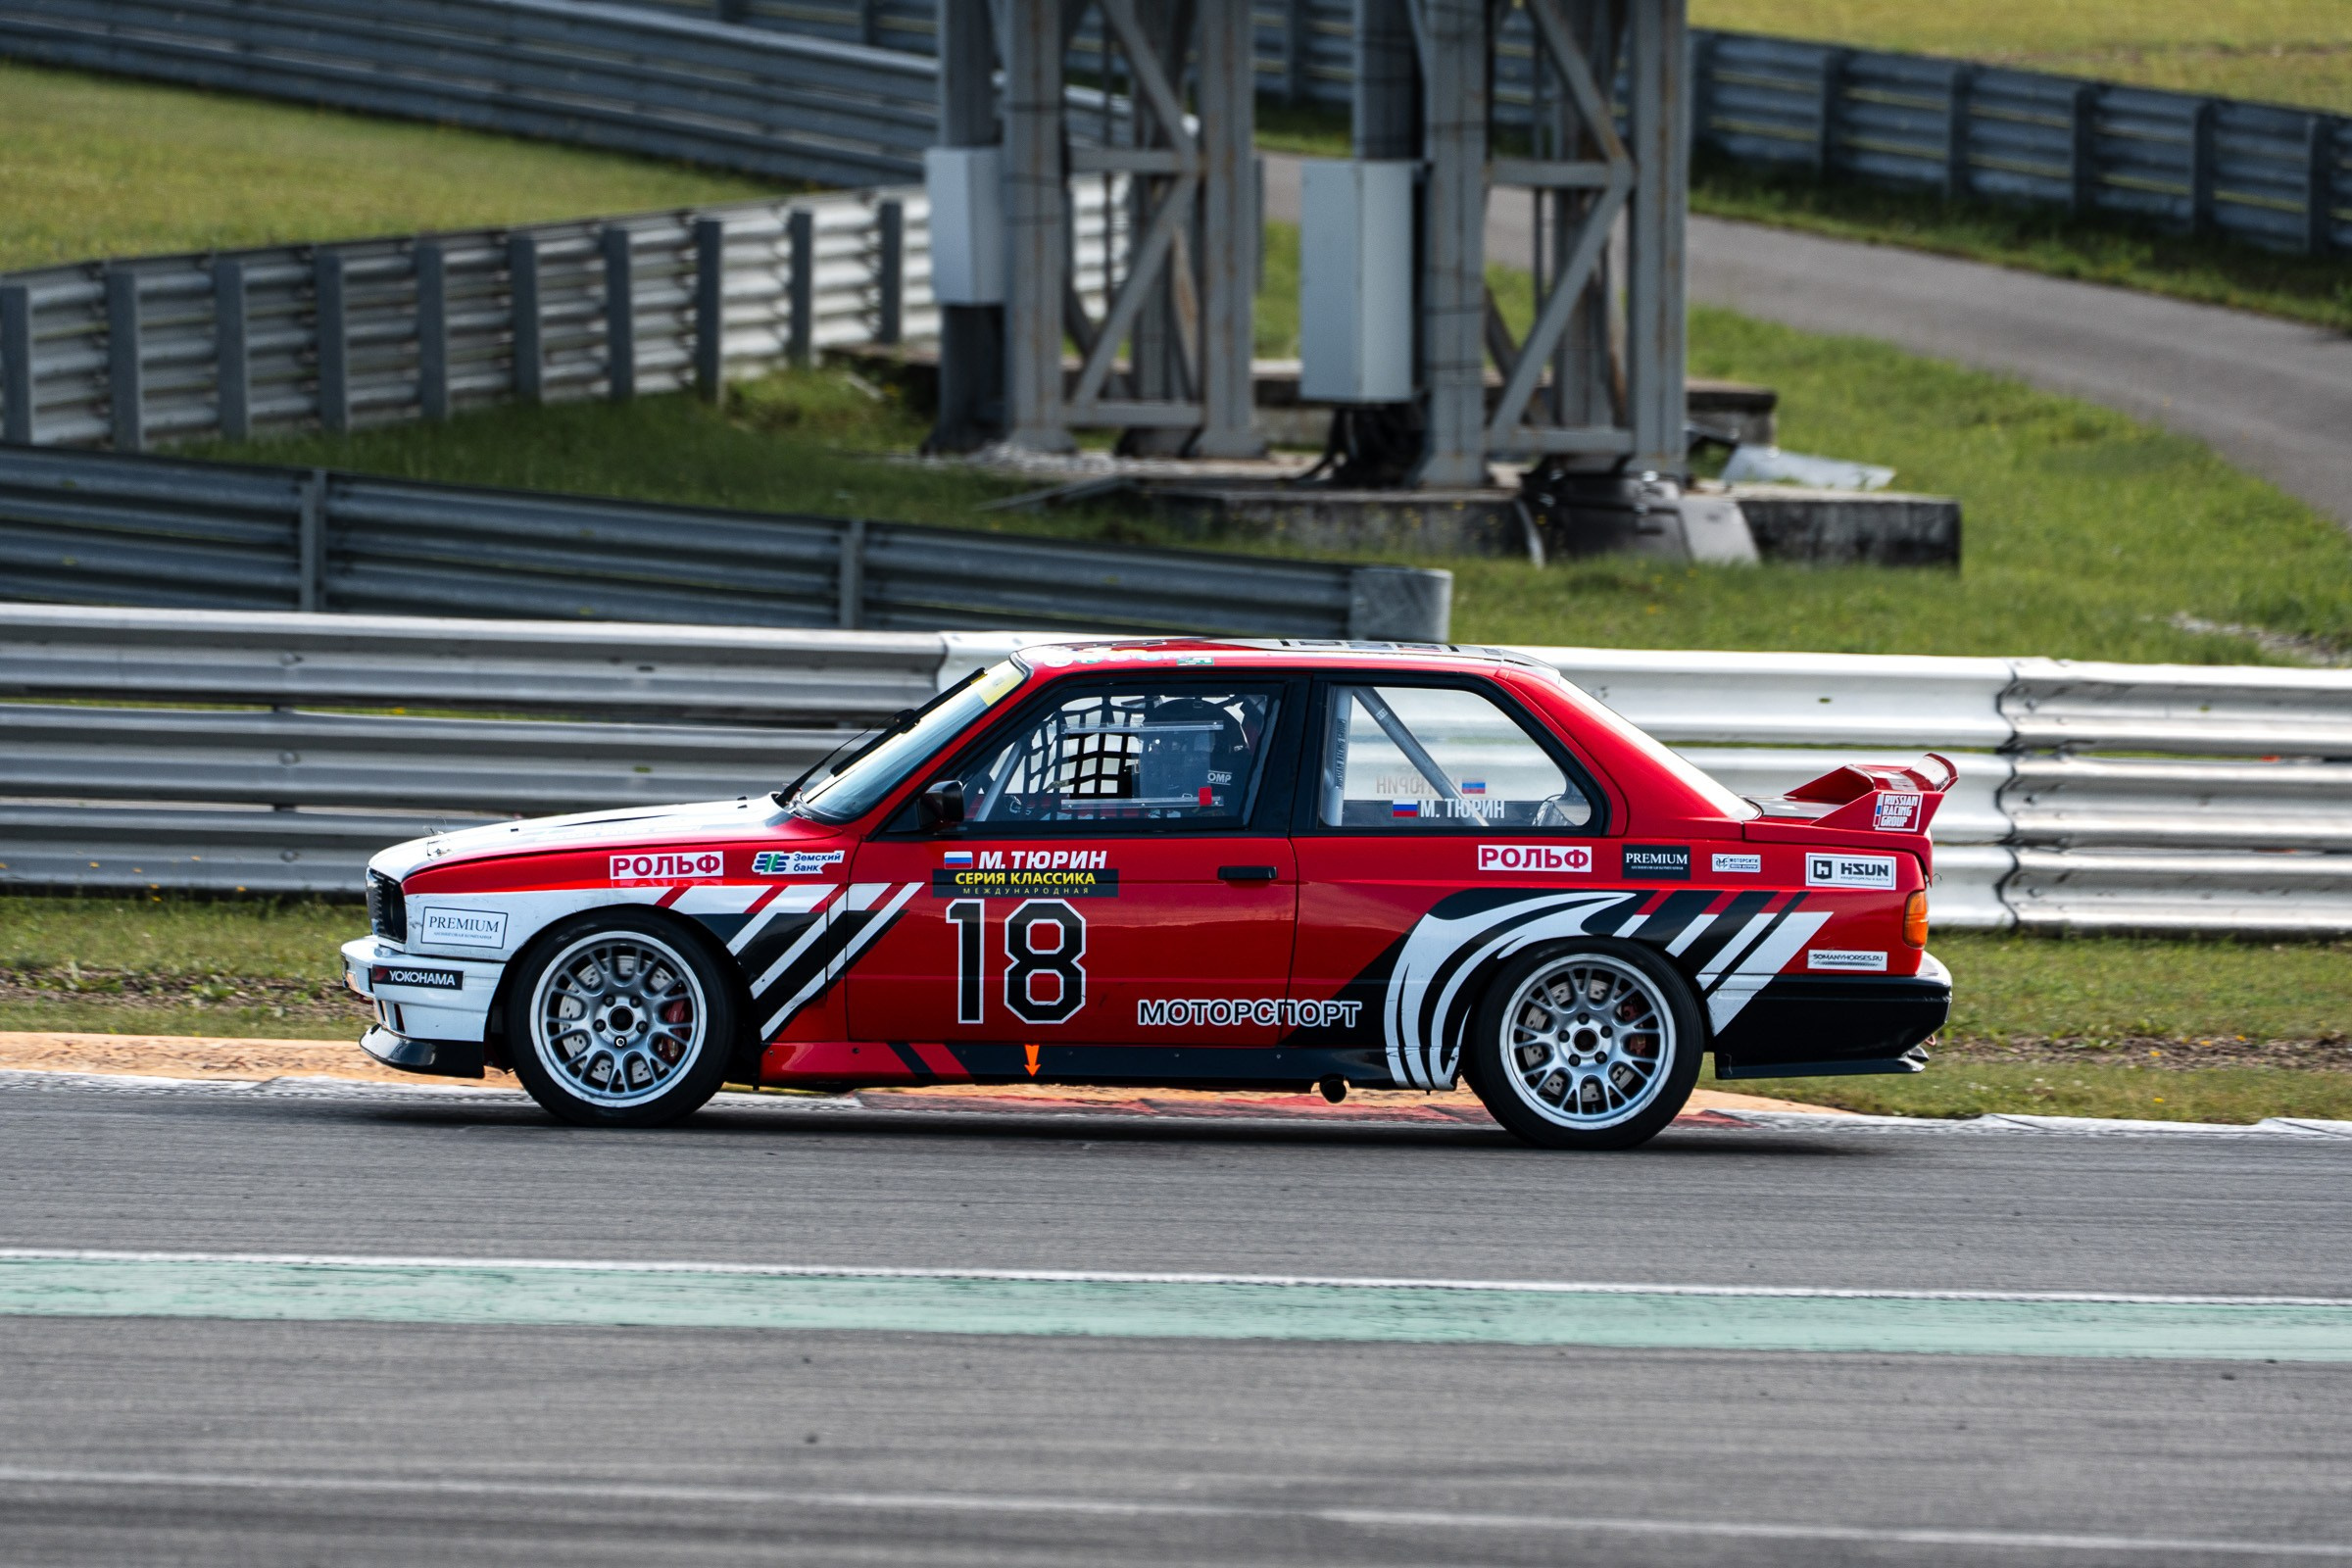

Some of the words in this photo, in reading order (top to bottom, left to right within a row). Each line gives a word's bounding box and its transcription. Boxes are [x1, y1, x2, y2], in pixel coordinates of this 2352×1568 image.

[1207, 772, 1232, 783] OMP
[1885, 795, 1919, 807] RUSSIAN
[1420, 800, 1441, 818] М.
[1445, 799, 1505, 819] ТЮРИН
[1883, 805, 1913, 816] RACING
[1881, 815, 1908, 827] GROUP
[793, 852, 842, 861] Земский
[1010, 851, 1107, 869] ТЮРИН
[1481, 848, 1589, 869] РОЛЬФ
[1625, 853, 1688, 864] PREMIUM
[612, 855, 720, 877] РОЛЬФ
[793, 862, 819, 871] банк
[1840, 862, 1888, 877] HSUN
[955, 872, 1005, 885] СЕРИЯ
[1010, 872, 1097, 885] КЛАССИКА
[429, 915, 500, 933] PREMIUM
[945, 899, 1087, 1024] 18
[388, 970, 456, 986] YOKOHAMA
[1137, 999, 1362, 1027] МОТОРСПОРТ
